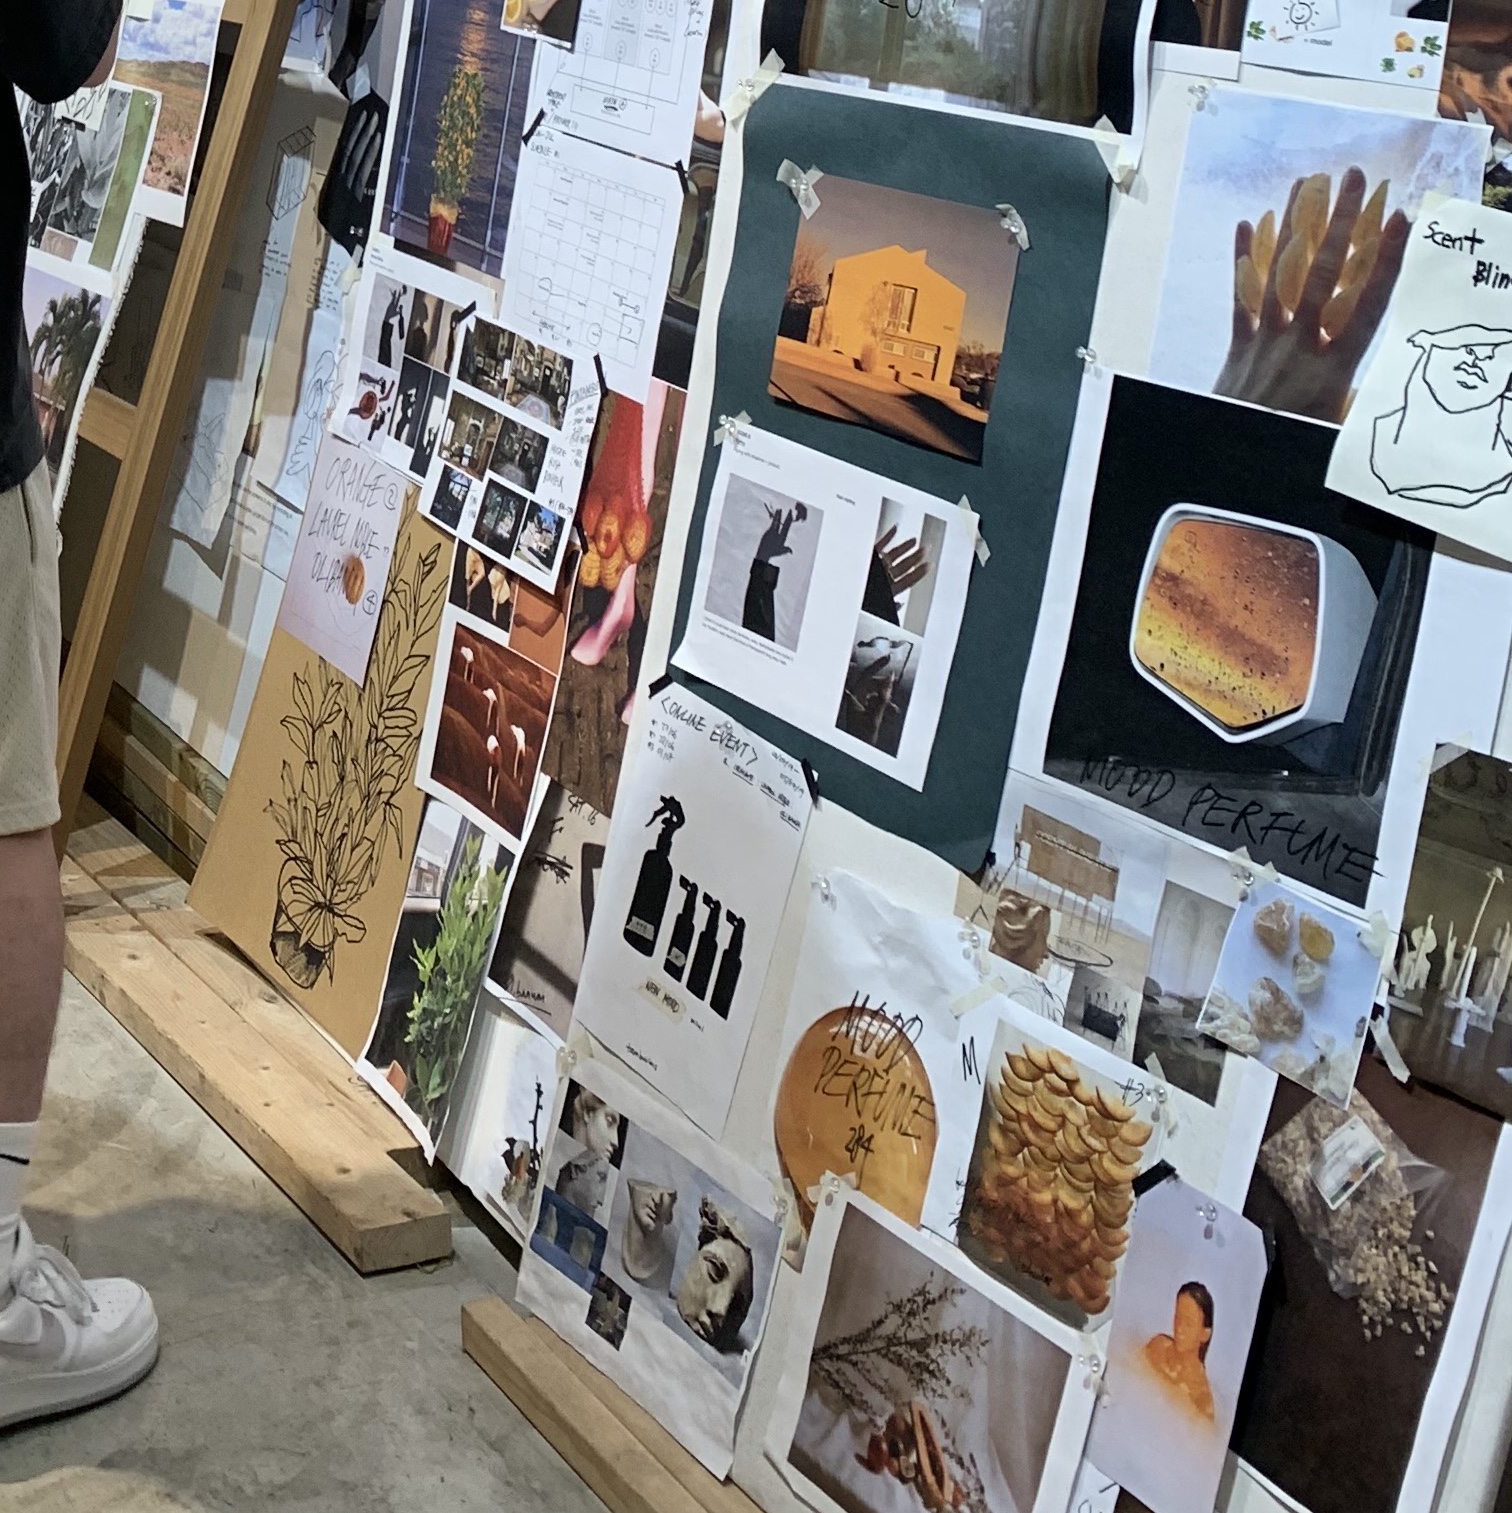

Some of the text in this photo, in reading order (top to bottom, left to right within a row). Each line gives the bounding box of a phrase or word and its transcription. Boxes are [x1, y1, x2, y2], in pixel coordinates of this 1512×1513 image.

[1422, 220, 1485, 256] Scent
[1472, 260, 1512, 290] Blin
[325, 457, 388, 512] ORANGE
[1080, 754, 1388, 882] MOOD PERFUME
[831, 990, 924, 1076] MOOD
[813, 1045, 936, 1140] PERFUME
[1114, 1078, 1145, 1107] #3
